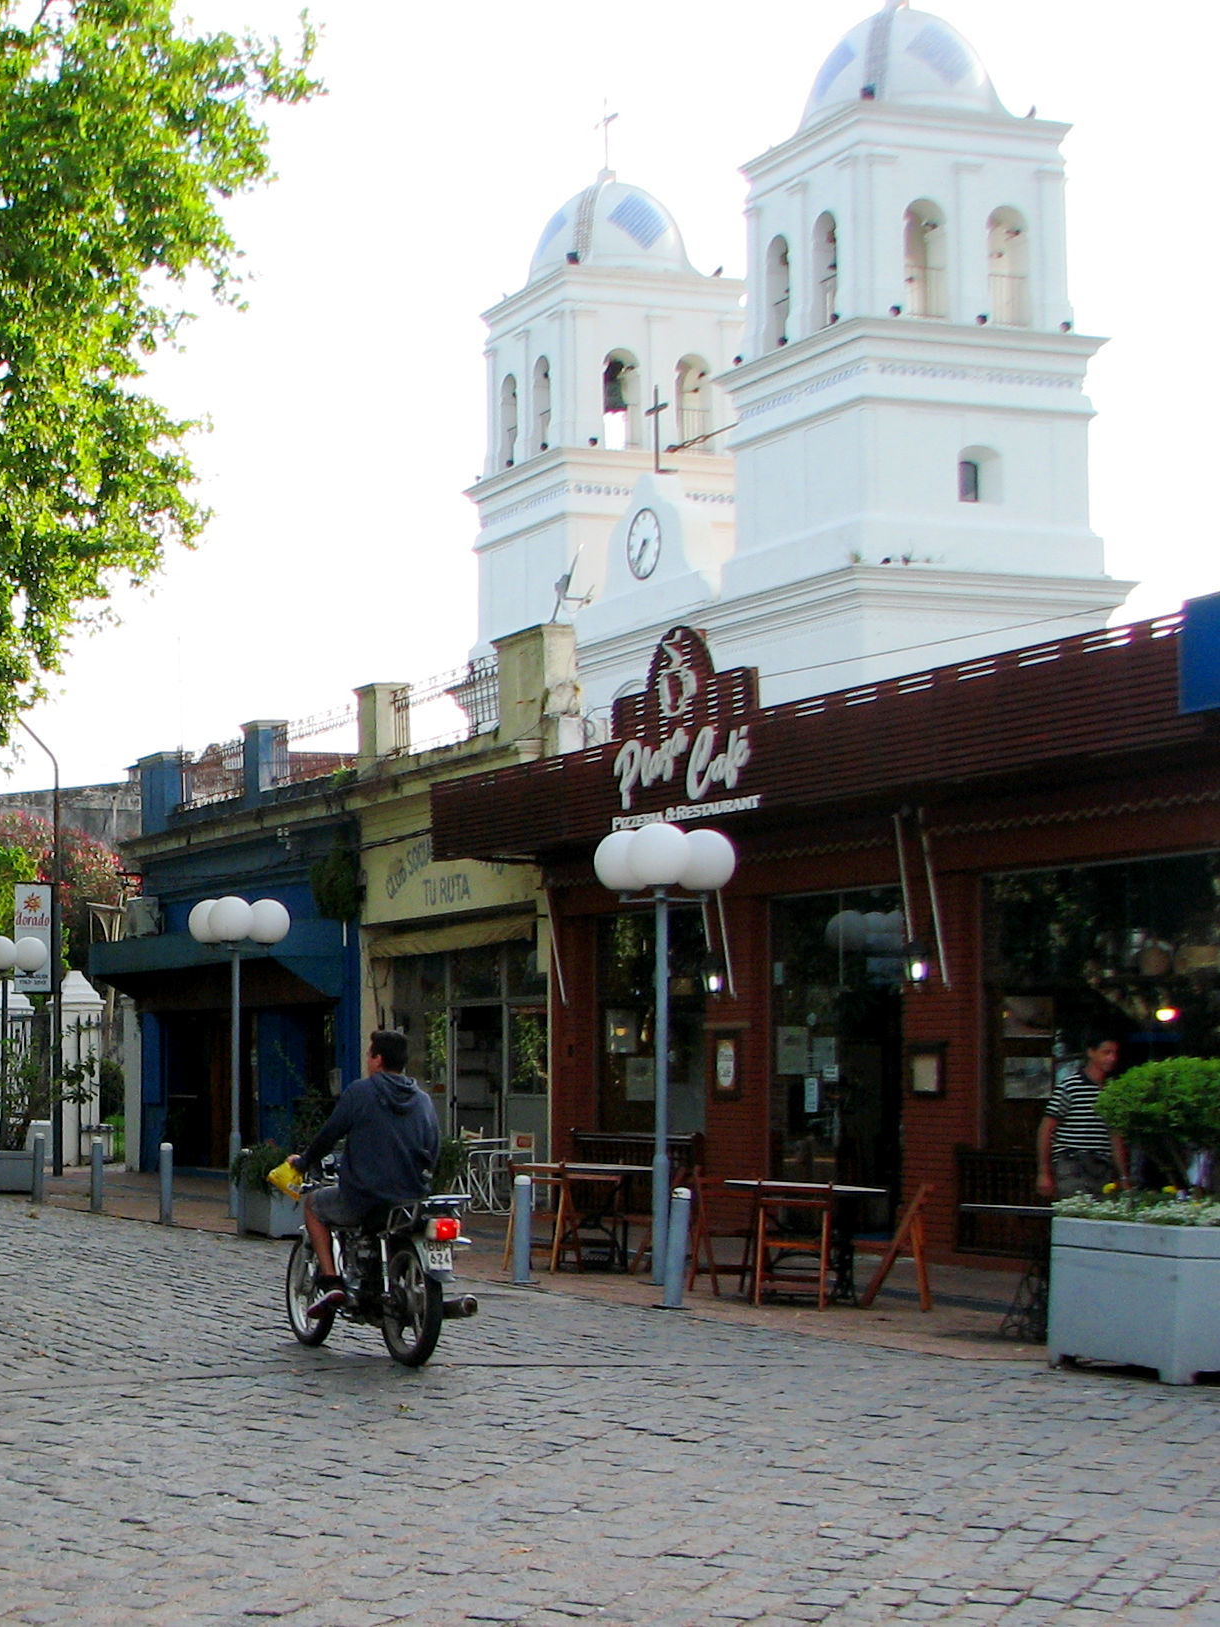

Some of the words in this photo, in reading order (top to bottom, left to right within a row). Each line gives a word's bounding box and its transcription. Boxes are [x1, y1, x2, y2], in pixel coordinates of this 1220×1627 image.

[614, 728, 689, 810] Plaza
[687, 726, 752, 801] Café
[423, 878, 436, 907] TU
[440, 873, 471, 904] RUTA
[15, 912, 50, 926] dorado
